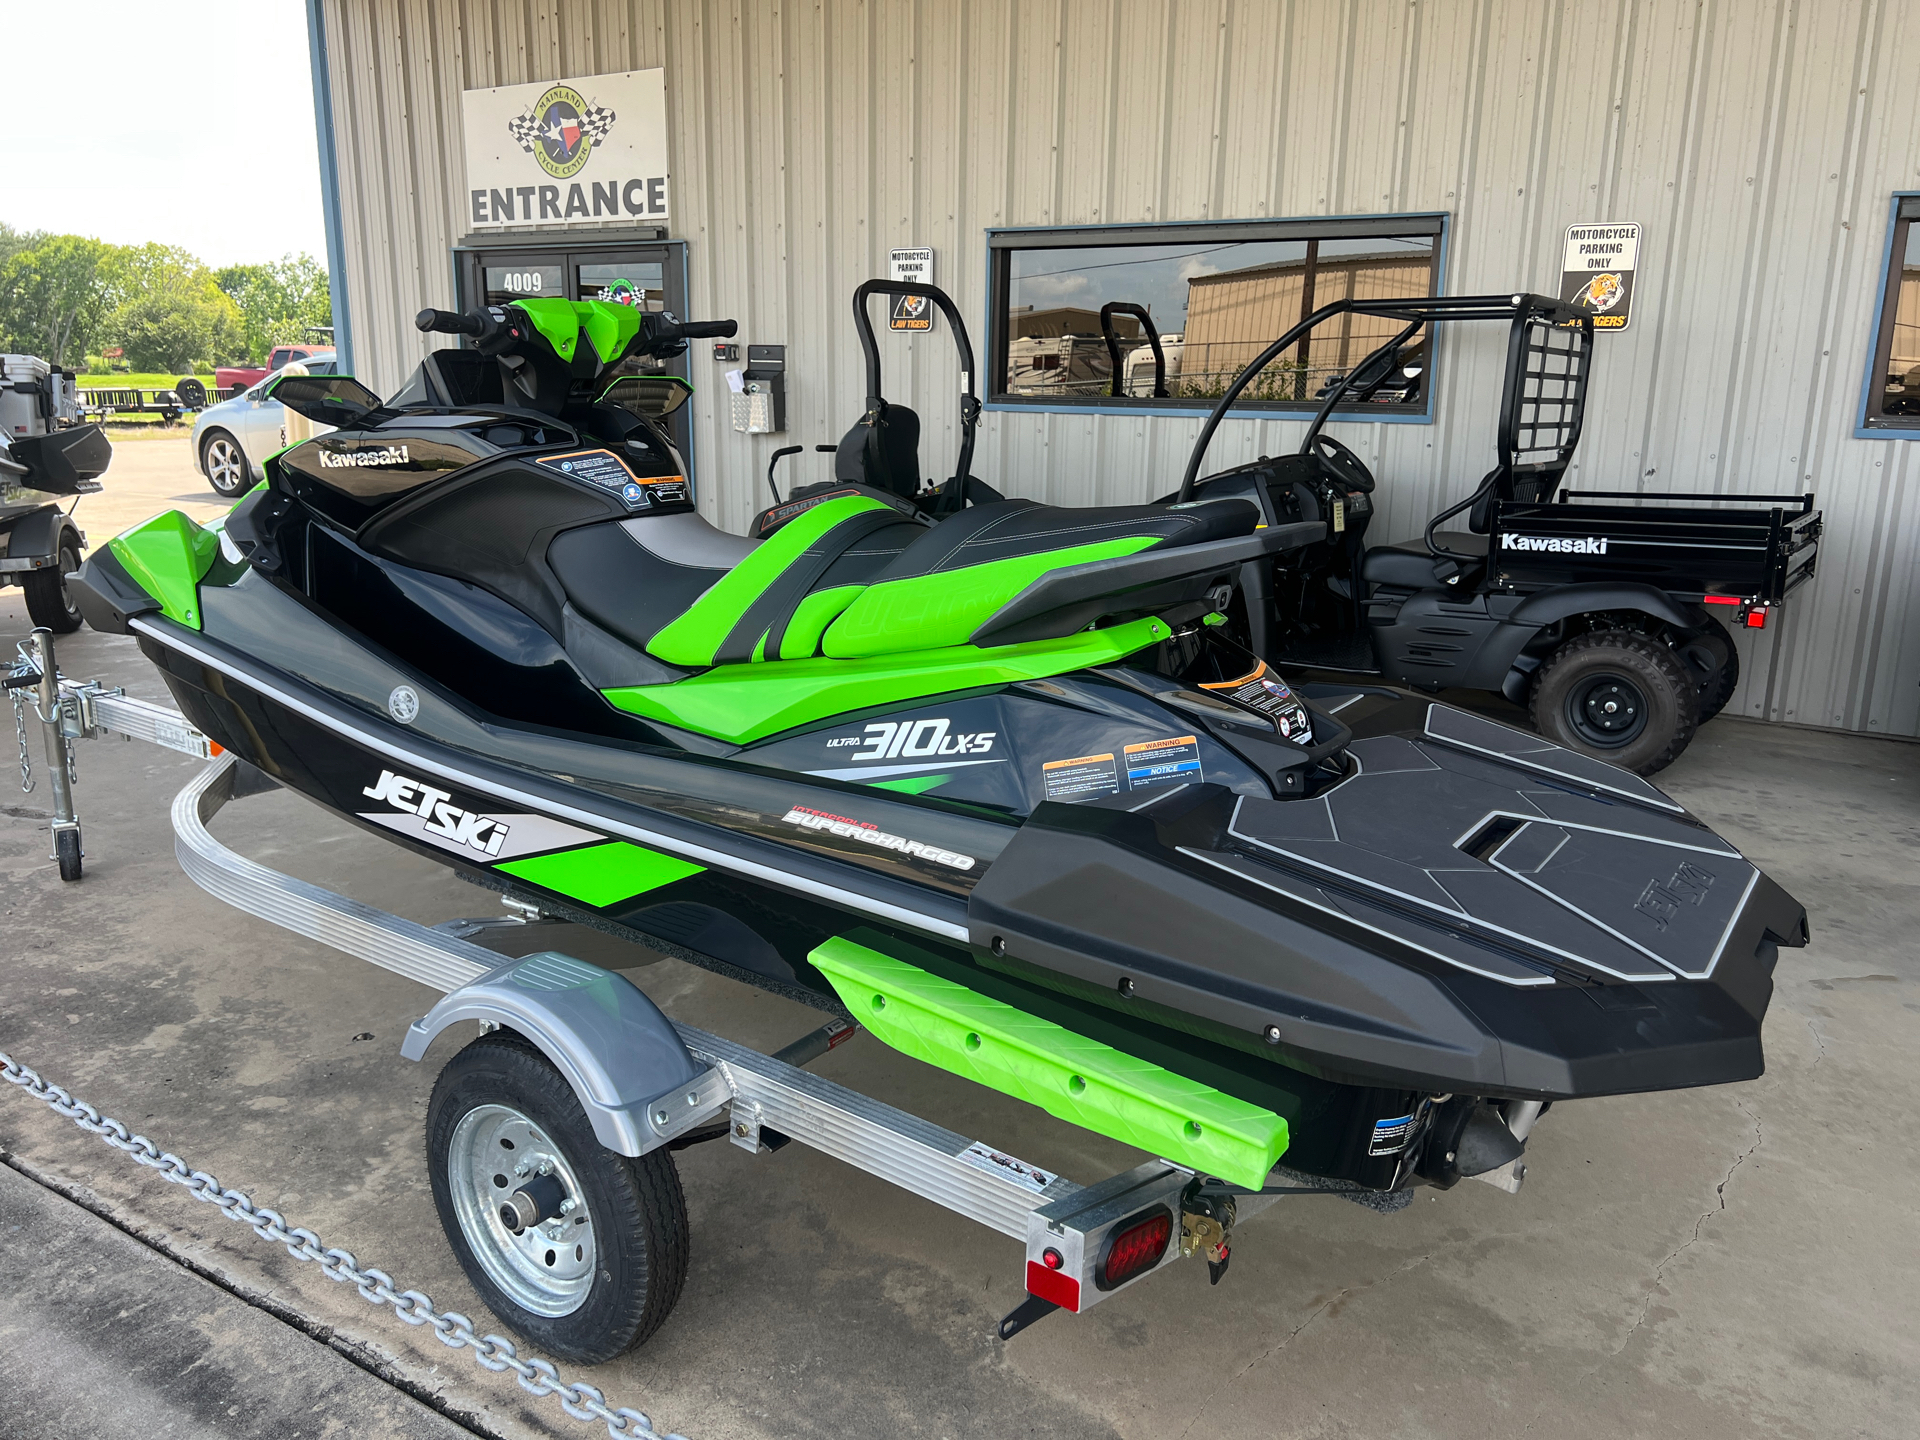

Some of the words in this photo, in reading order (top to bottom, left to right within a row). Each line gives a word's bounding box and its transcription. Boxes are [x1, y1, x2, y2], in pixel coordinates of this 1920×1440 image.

[539, 91, 581, 111] MAINLAND
[538, 151, 560, 174] CYCLE
[562, 147, 588, 174] CENTER
[471, 177, 666, 223] ENTRANCE
[1570, 228, 1636, 240] MOTORCYCLE
[1579, 243, 1623, 254] PARKING
[892, 252, 930, 260] MOTORCYCLE
[898, 263, 923, 272] PARKING
[1587, 258, 1611, 268] ONLY
[504, 273, 542, 292] 4009
[891, 320, 907, 328] LAW
[908, 320, 929, 328] TIGERS
[319, 445, 409, 468] Kawasaki
[778, 496, 828, 518] SPARTAN
[1501, 533, 1607, 554] Kawasaki
[826, 737, 860, 747] ULTRA
[1145, 739, 1181, 750] WARNING
[1069, 757, 1094, 765] WARNING
[1150, 765, 1179, 775] NOTICE
[792, 805, 878, 830] INTERCOOLED
[781, 810, 976, 871] SUPERCHARGED
